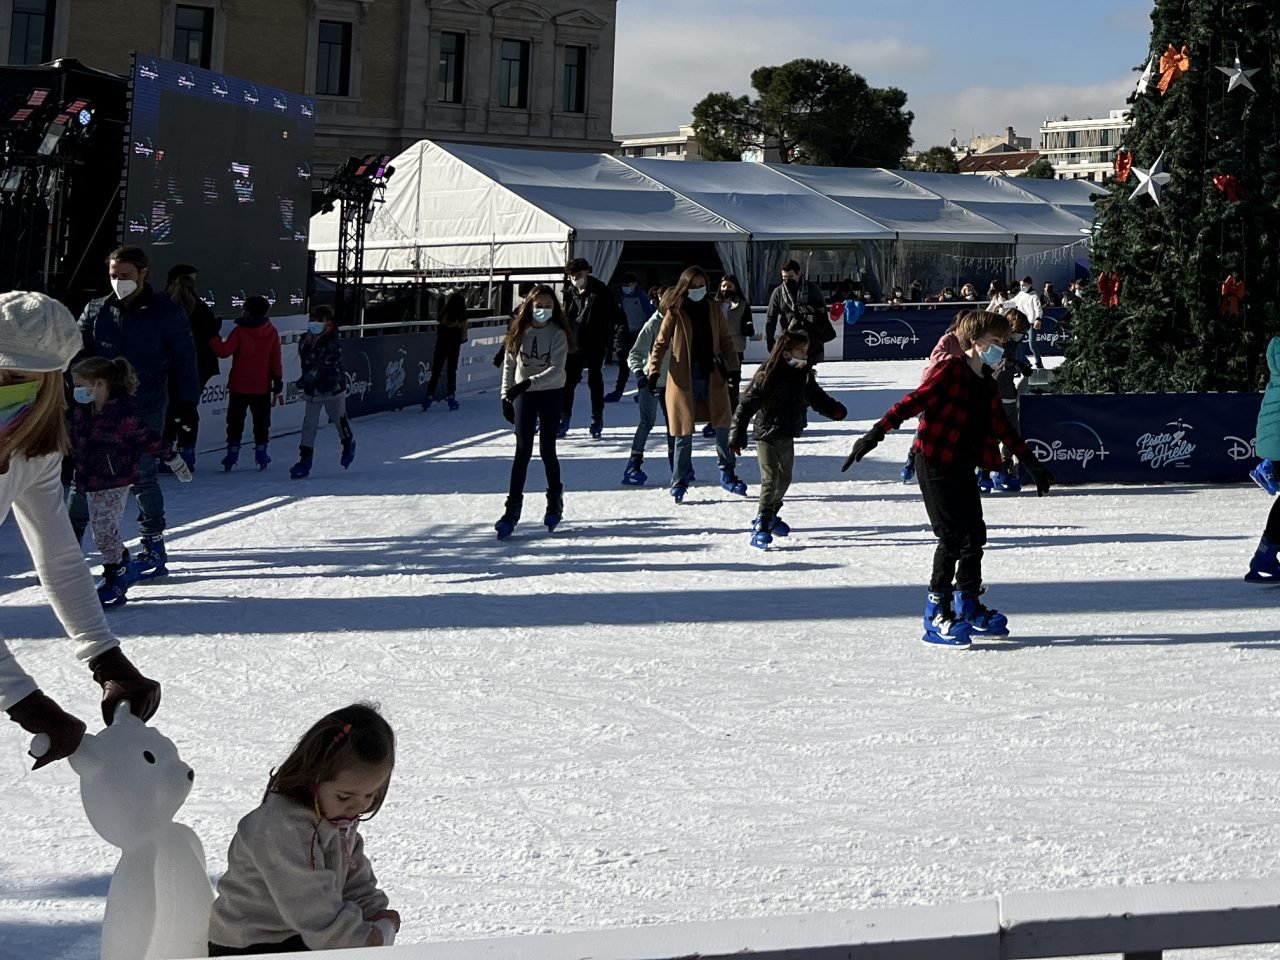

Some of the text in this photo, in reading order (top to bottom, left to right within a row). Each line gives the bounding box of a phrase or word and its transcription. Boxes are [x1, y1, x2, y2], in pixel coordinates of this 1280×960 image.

[861, 329, 920, 350] Disney+
[1024, 437, 1111, 469] Disney+
[1135, 433, 1173, 450] Pista
[1137, 447, 1156, 462] de
[1150, 439, 1197, 469] Hielo
